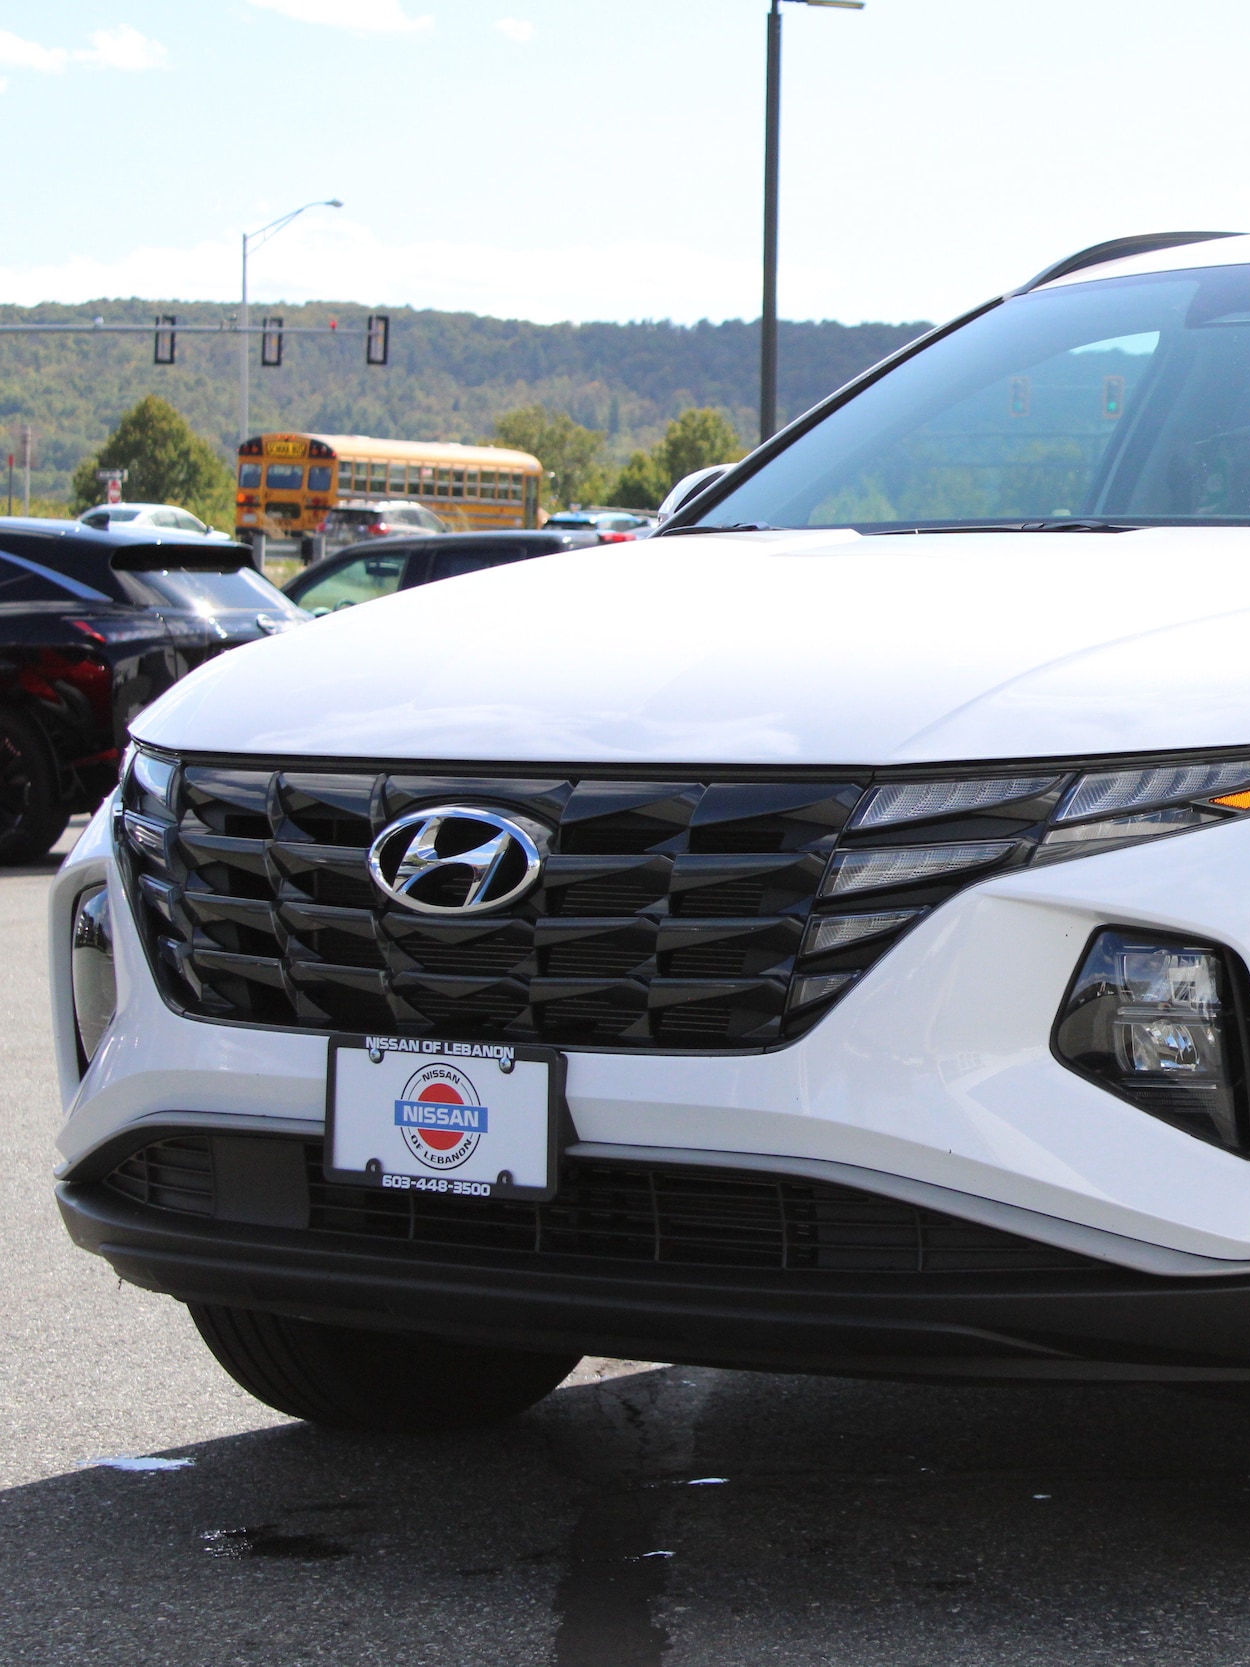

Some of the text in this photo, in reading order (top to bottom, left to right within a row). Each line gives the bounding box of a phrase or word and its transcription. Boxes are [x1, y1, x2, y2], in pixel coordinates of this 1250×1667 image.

[366, 1037, 515, 1059] NISSAN OF LEBANON
[422, 1069, 461, 1085] NISSAN
[404, 1105, 479, 1128] NISSAN
[411, 1134, 472, 1165] OF LEBANON
[382, 1175, 491, 1197] 603-448-3500
